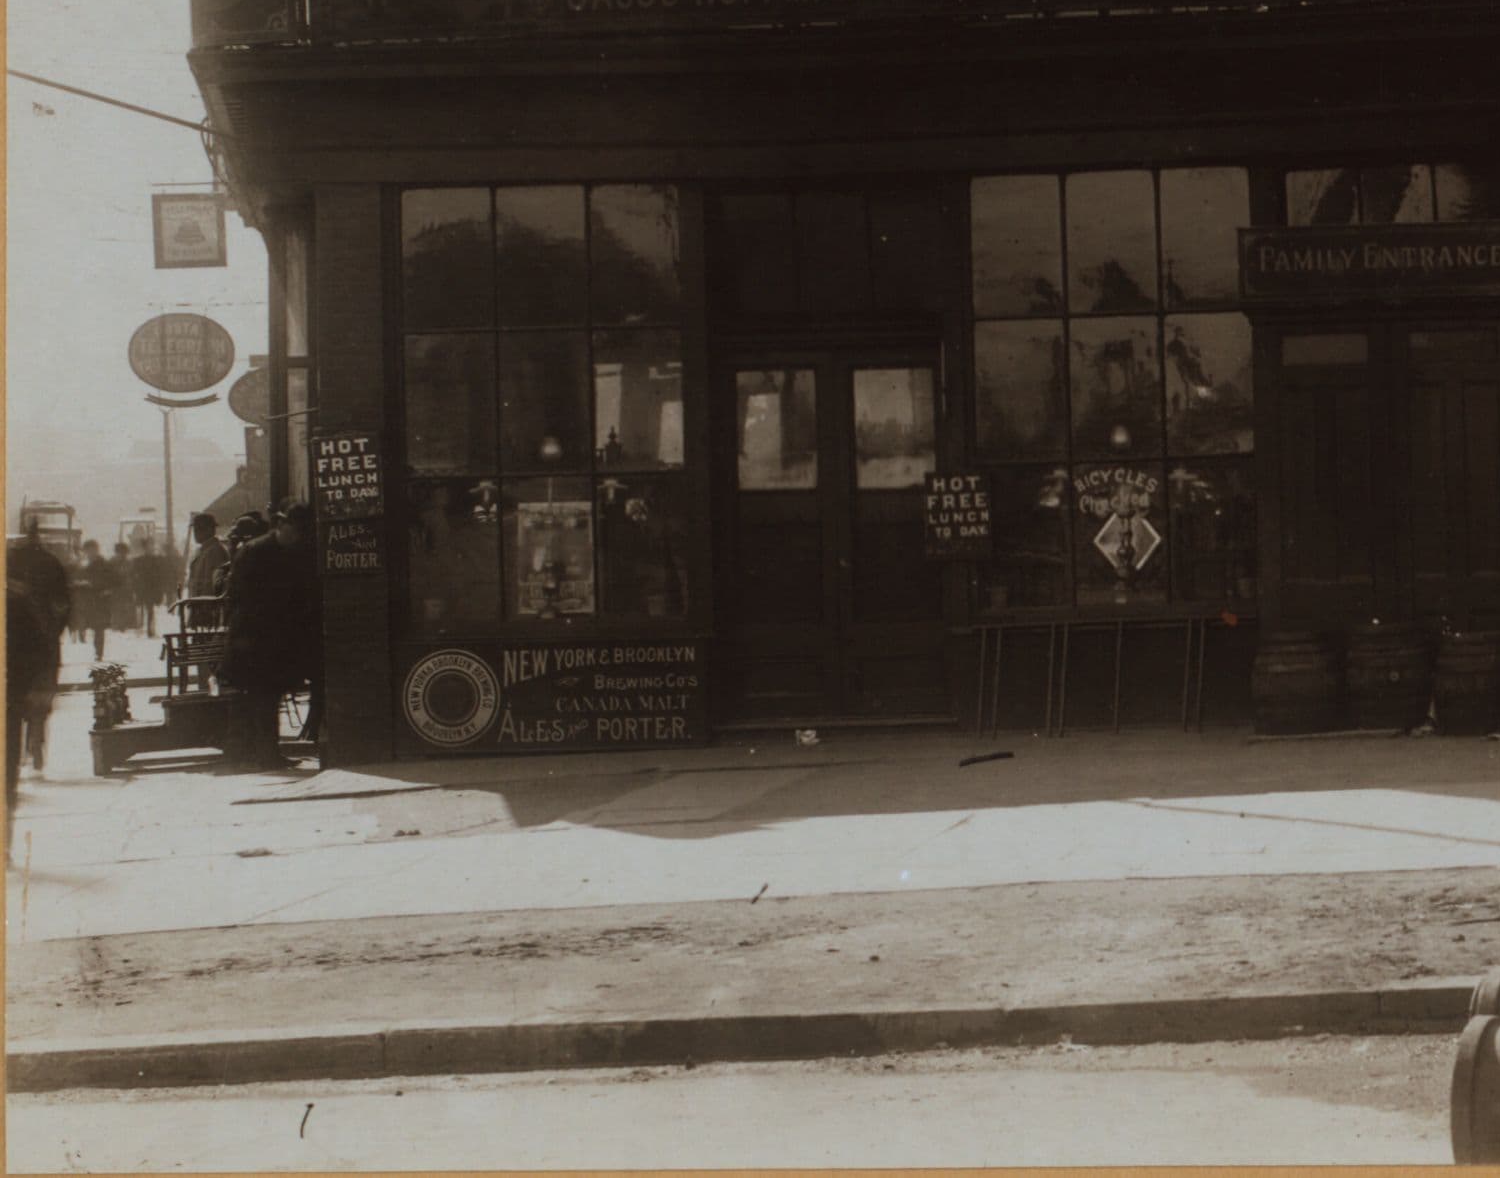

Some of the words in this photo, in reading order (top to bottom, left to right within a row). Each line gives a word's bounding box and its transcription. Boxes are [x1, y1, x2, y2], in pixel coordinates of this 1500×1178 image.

[1258, 245, 1357, 272] FAMILY
[320, 438, 369, 456] HOT
[317, 454, 377, 474] FREE
[318, 472, 378, 488] LUNCH
[932, 476, 981, 493] HOT
[1073, 468, 1159, 493] BICYCLES
[326, 489, 343, 501] TO
[926, 492, 988, 510] FREE
[928, 510, 990, 524] LUNCH
[935, 526, 952, 539] TO
[503, 649, 549, 688] NEW
[552, 646, 598, 671] YORK
[599, 649, 612, 664] &
[612, 645, 697, 665] BROOKLYN
[593, 674, 662, 692] BREWING
[556, 693, 633, 713] CANADA
[638, 692, 690, 711] MALT
[497, 706, 566, 743] ALES
[596, 717, 693, 742] PORTER.
